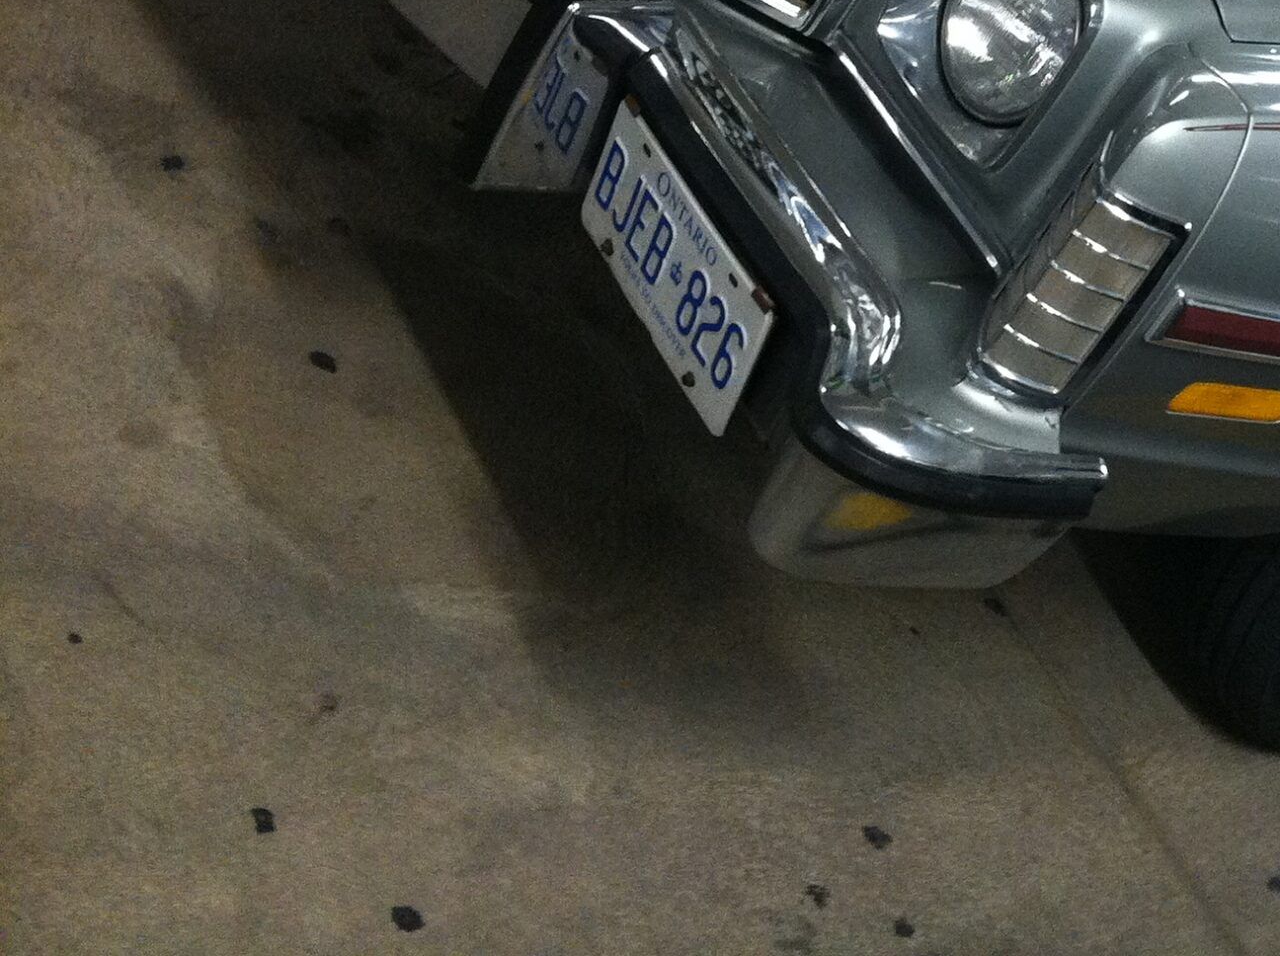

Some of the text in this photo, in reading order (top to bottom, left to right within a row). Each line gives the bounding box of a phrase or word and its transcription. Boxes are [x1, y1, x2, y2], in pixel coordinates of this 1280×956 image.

[595, 140, 746, 390] BJEB 826
[656, 171, 718, 266] ONTARIO
